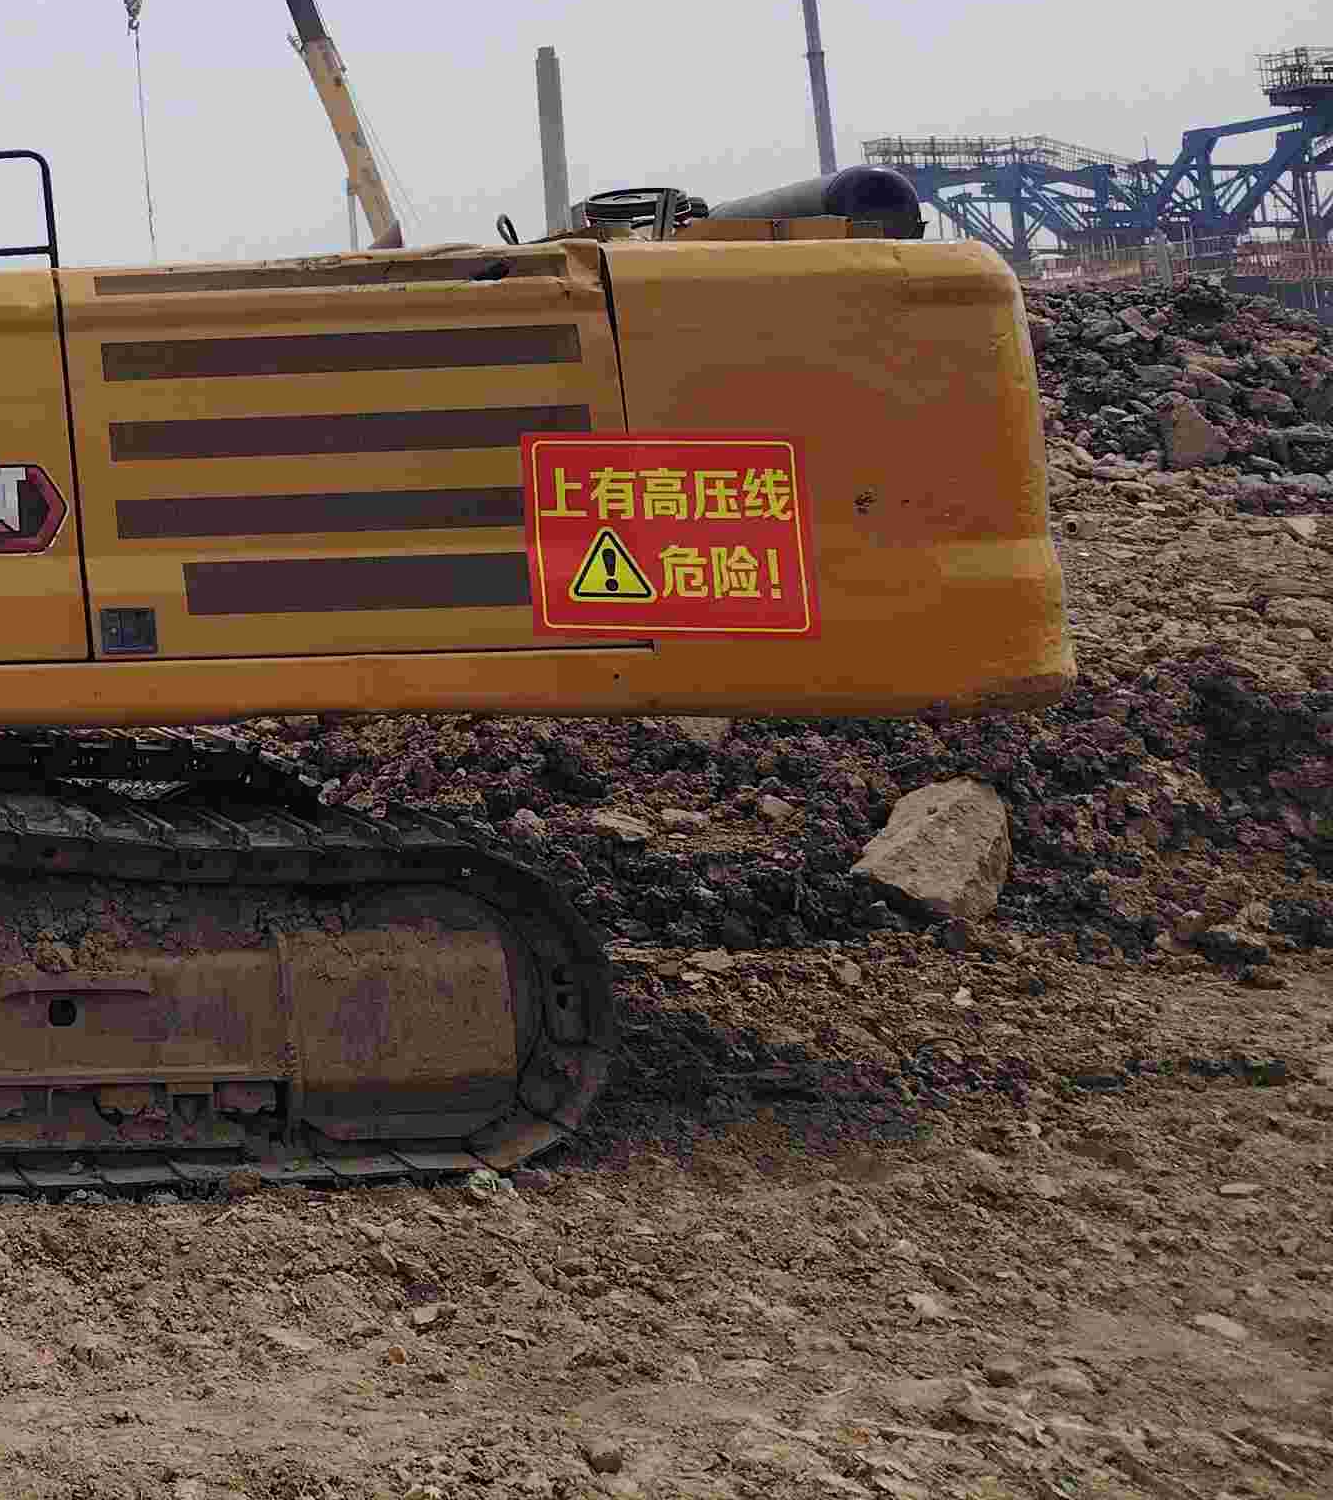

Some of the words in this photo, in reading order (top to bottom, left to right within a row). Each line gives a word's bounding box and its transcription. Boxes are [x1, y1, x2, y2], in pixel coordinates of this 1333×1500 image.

[540, 467, 792, 520] 上有高压线
